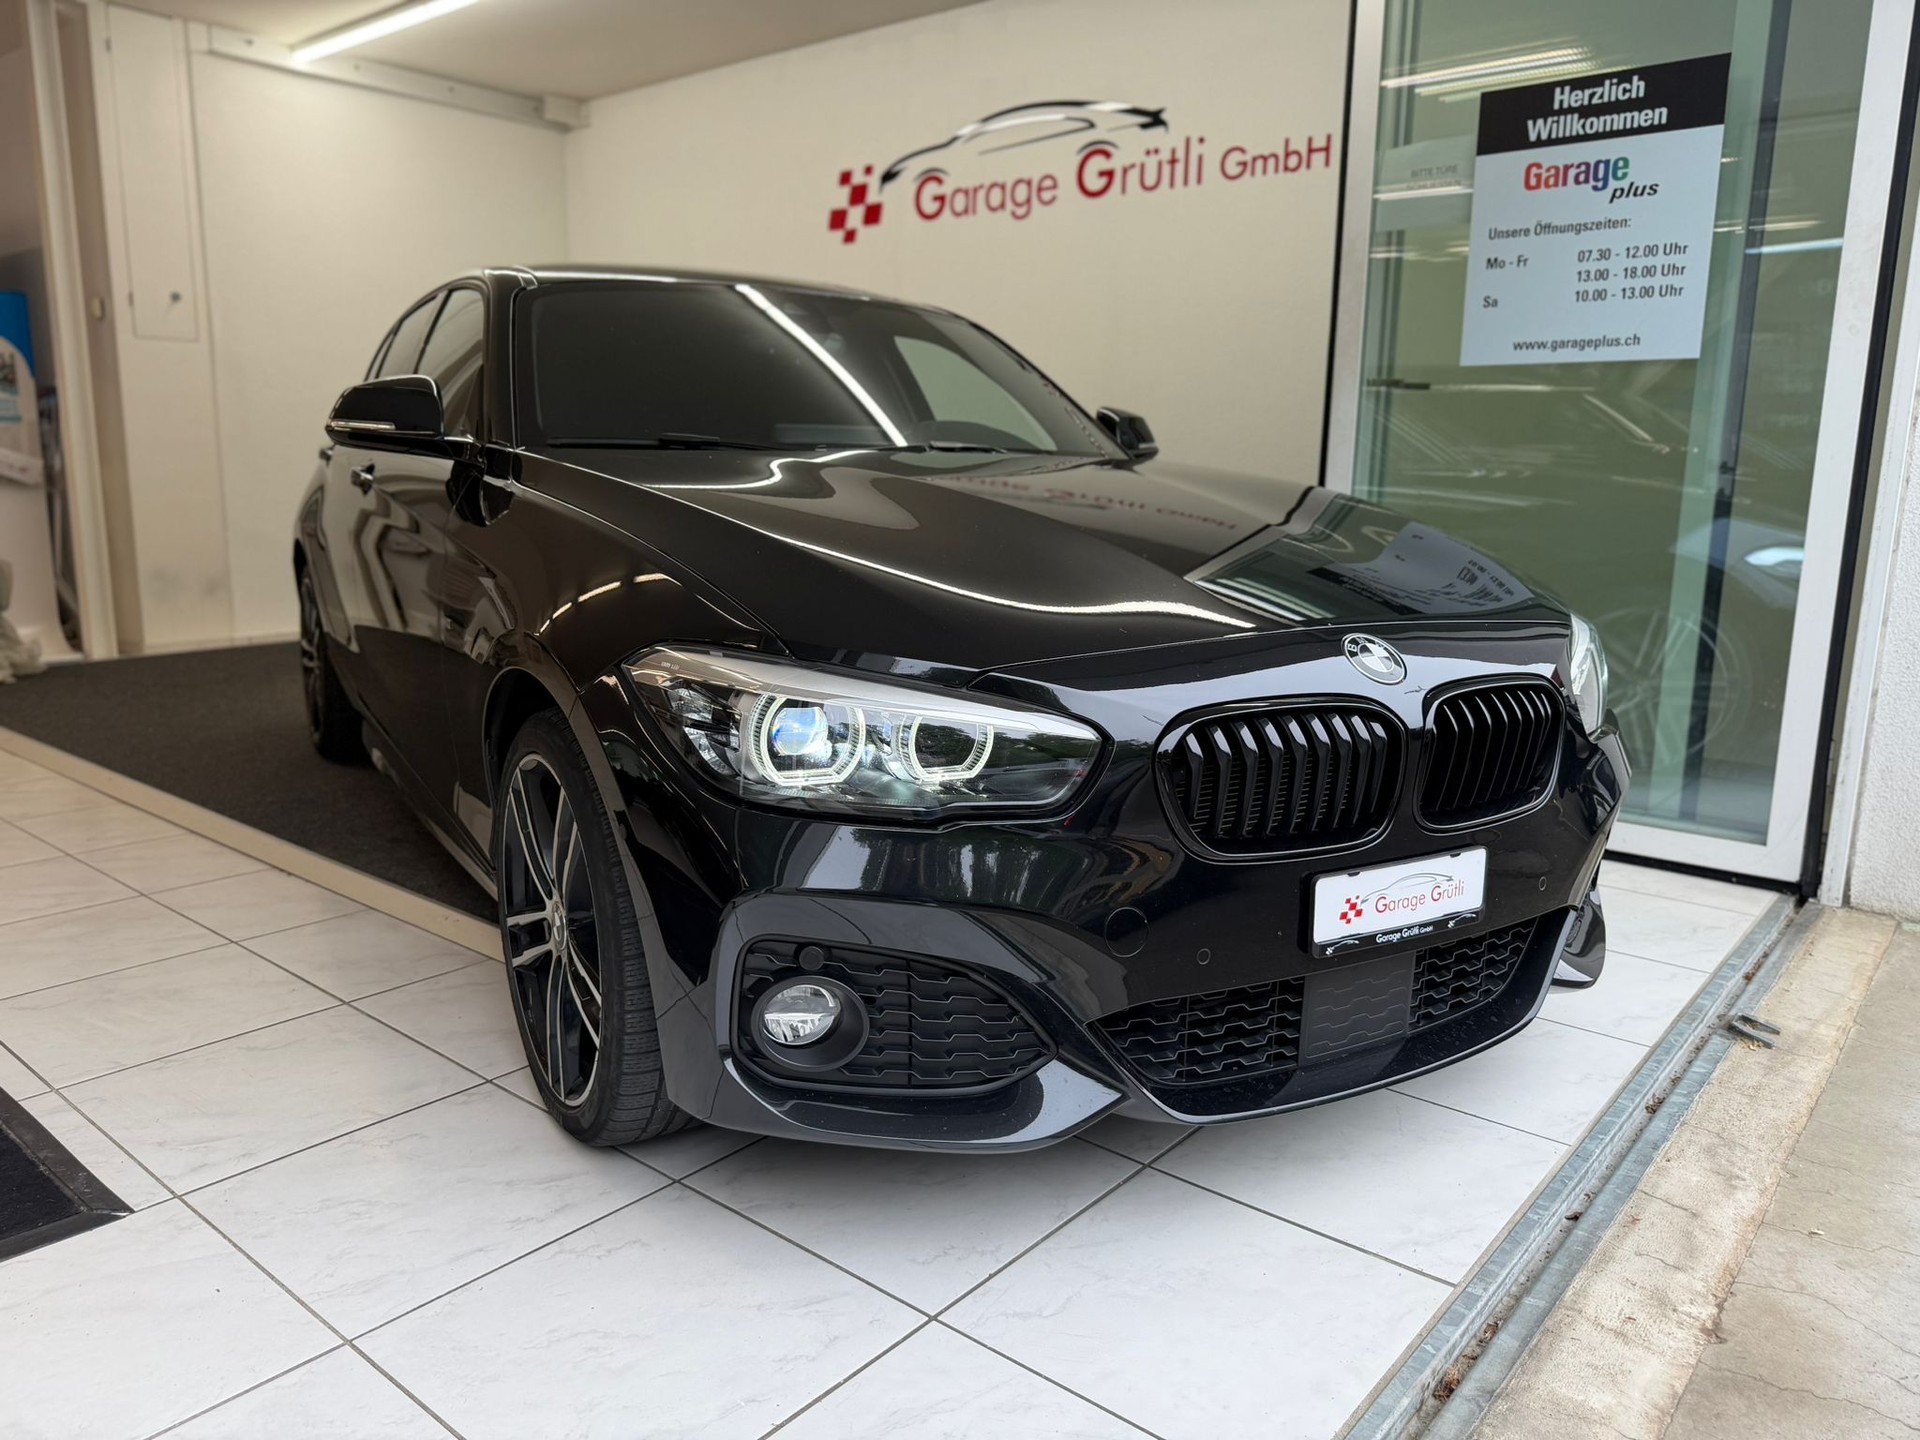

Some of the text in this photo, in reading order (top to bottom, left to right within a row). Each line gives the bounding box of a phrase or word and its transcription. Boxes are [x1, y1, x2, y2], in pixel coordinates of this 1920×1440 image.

[1553, 75, 1646, 110] Herzlich
[1527, 106, 1668, 142] Willkommen
[914, 134, 1332, 220] Garage Grütli GmbH
[1524, 156, 1630, 192] Garage
[1609, 181, 1660, 204] plus
[1488, 217, 1632, 240] Unsere Öffnungszeiten:
[1486, 257, 1505, 270] Mo
[1517, 255, 1529, 268] Fr
[1577, 248, 1611, 263] 07.30
[1625, 244, 1659, 259] 12.00
[1663, 242, 1689, 256] Uhr
[1576, 268, 1609, 283] 13.00
[1623, 265, 1656, 280] 18.00
[1661, 263, 1686, 278] Uhr
[1483, 296, 1498, 308] Sa
[1574, 288, 1607, 303] 10.00
[1621, 285, 1654, 300] 13.00
[1659, 284, 1684, 298] Uhr
[1513, 333, 1640, 352] www.garageplus.ch
[1375, 880, 1464, 913] Garage Grütli
[1376, 932, 1401, 943] Garage
